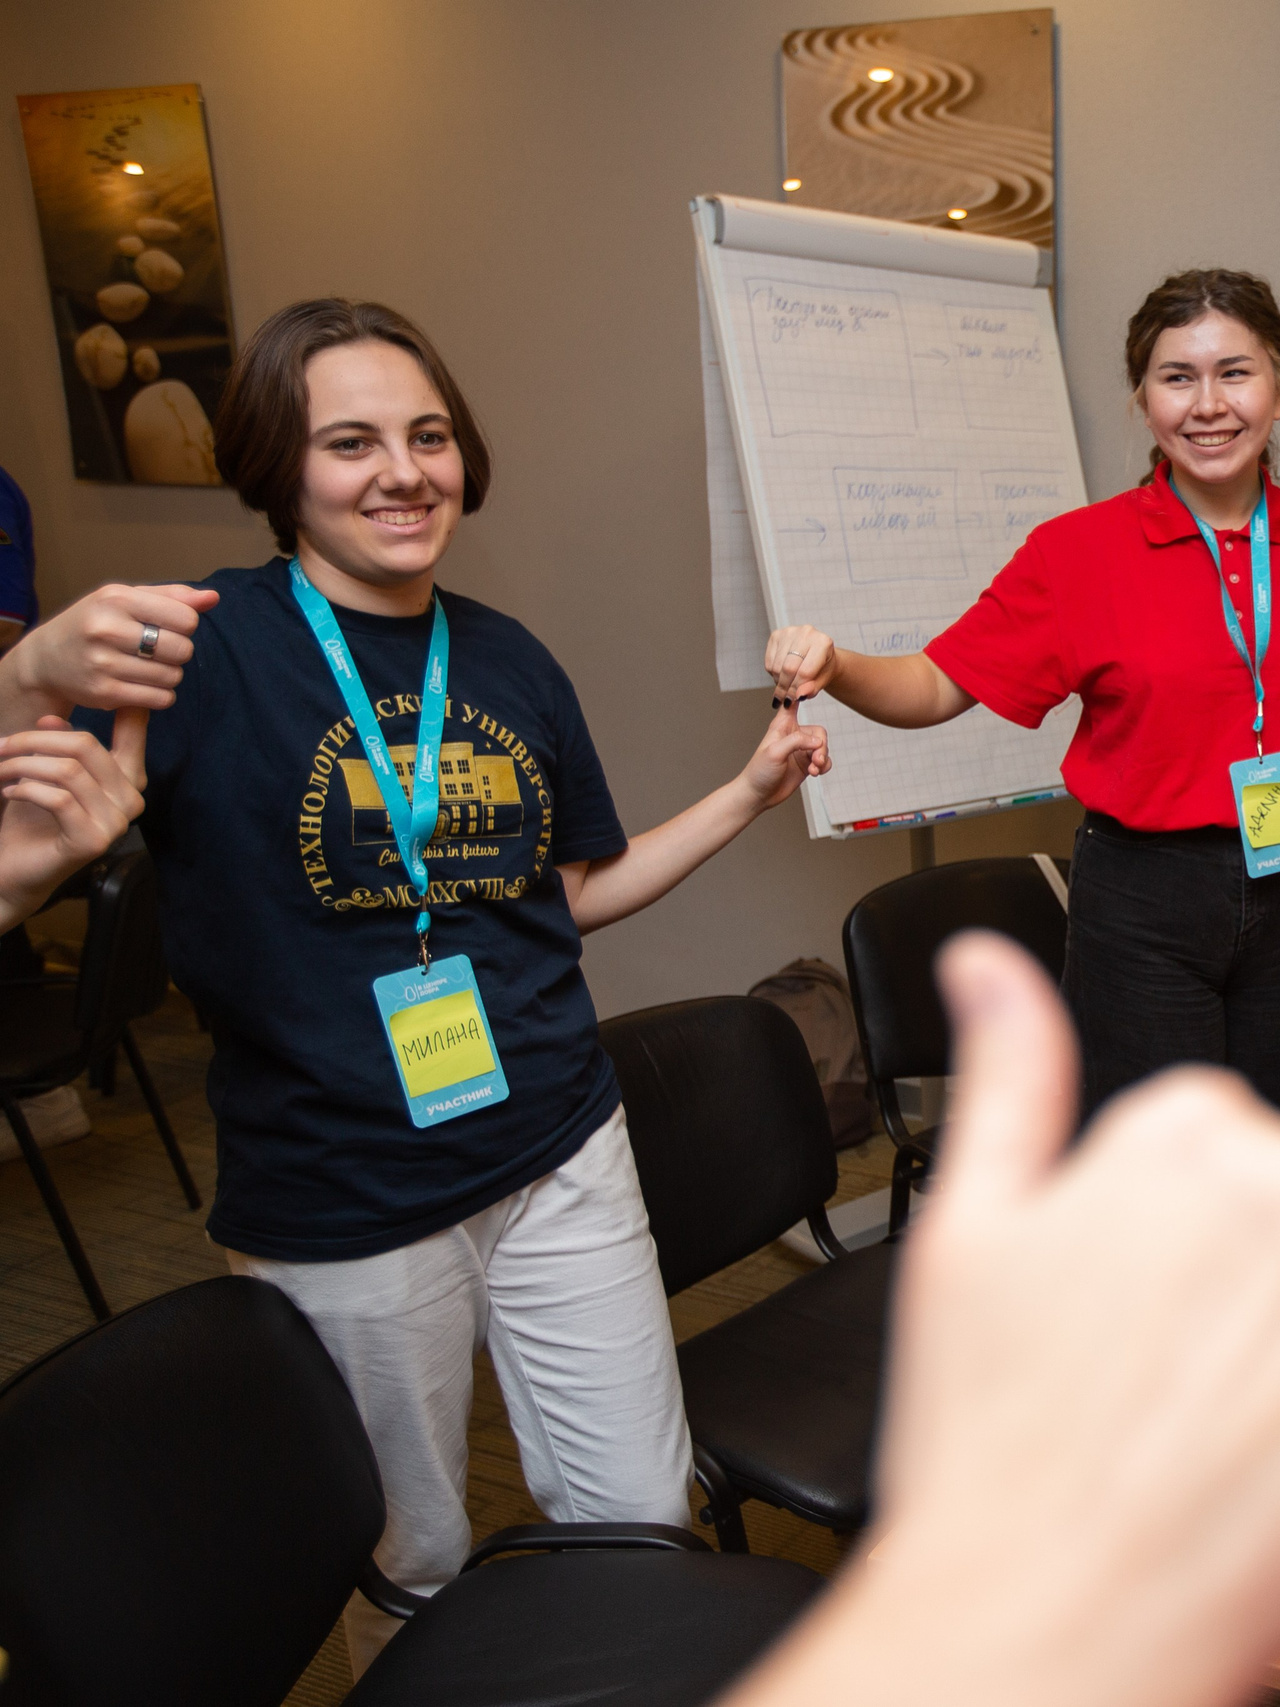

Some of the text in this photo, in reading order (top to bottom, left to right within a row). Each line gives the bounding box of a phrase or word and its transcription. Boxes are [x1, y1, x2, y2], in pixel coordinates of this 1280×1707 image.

[300, 694, 453, 895] ТЕХНОЛОГИСК
[378, 849, 402, 867] Cu
[422, 845, 444, 859] obis
[447, 844, 459, 859] in
[462, 843, 500, 860] futuro
[402, 1018, 480, 1066] МИЛАНА
[426, 1086, 493, 1116] УЧАСТНИК
